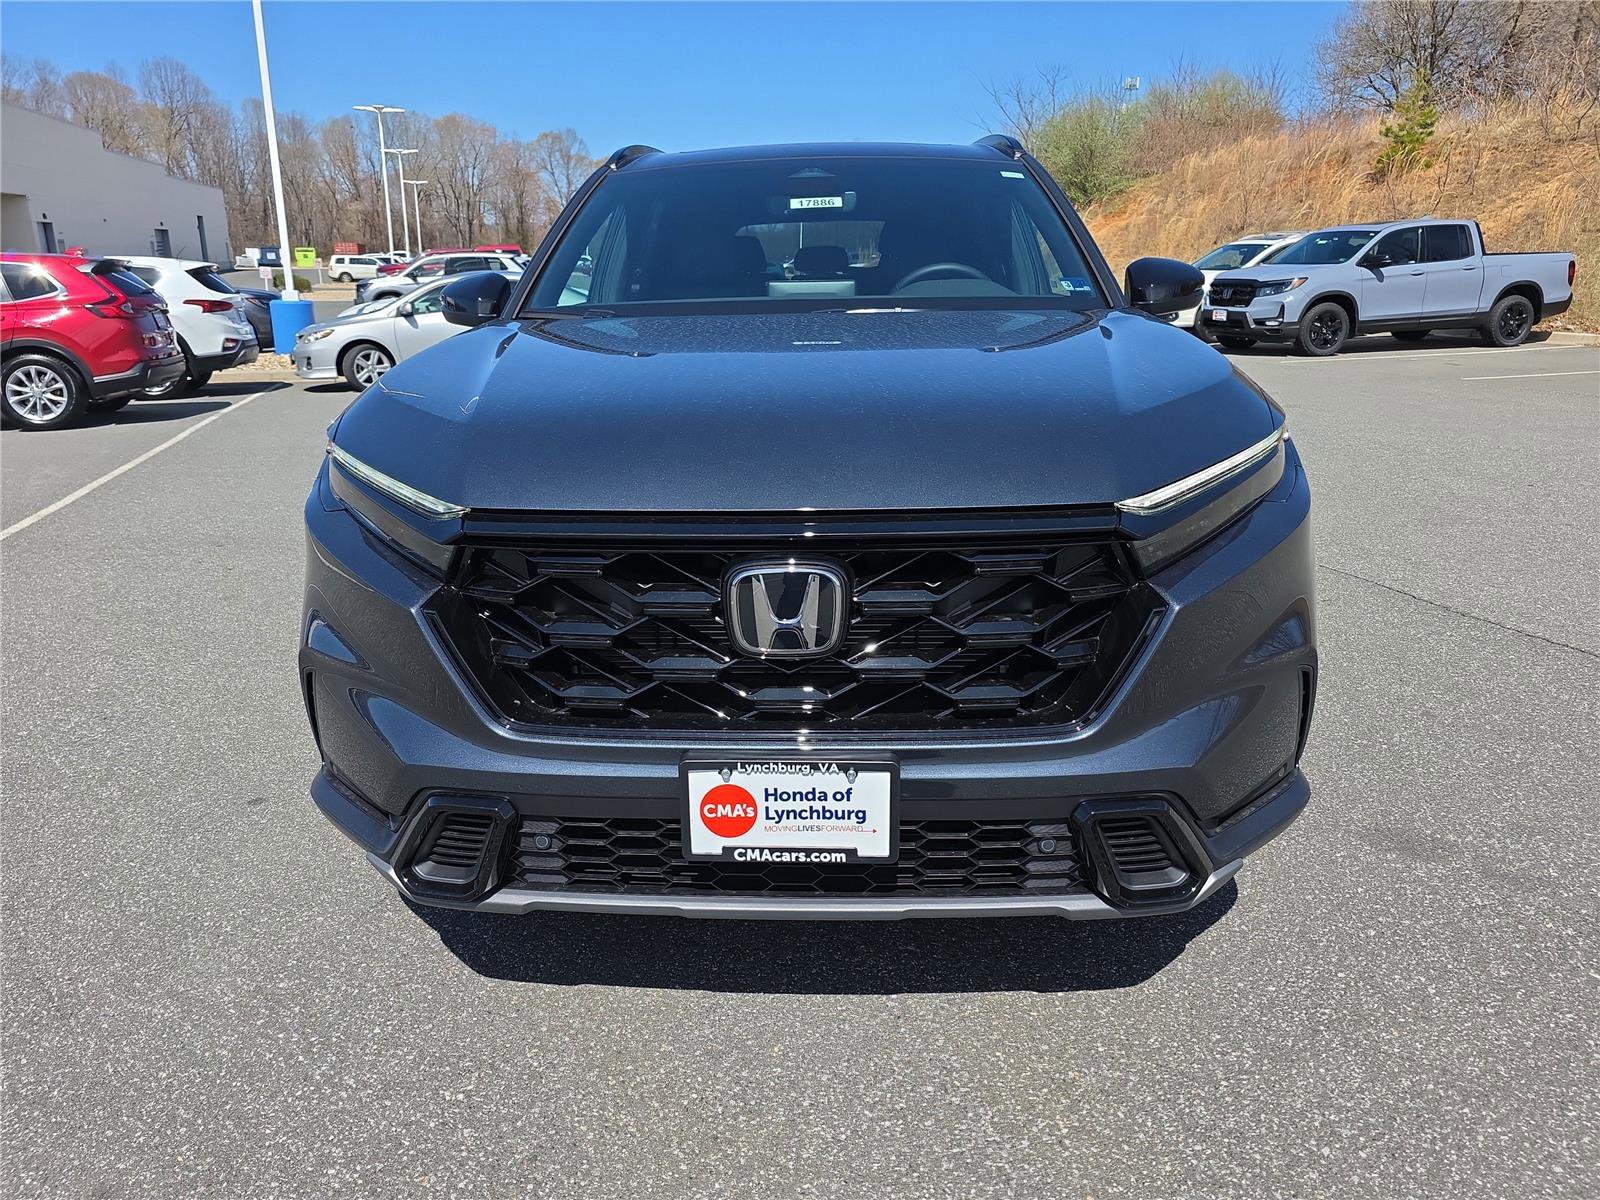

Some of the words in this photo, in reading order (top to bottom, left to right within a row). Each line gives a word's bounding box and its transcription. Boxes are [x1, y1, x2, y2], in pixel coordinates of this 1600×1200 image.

[798, 198, 836, 207] 17886
[737, 762, 815, 776] Lynchburg,
[818, 762, 840, 774] VA
[764, 787, 828, 802] Honda
[832, 787, 853, 802] of
[703, 803, 755, 819] CMA's
[764, 805, 867, 824] Lynchburg
[733, 848, 847, 863] CMAcars.com
